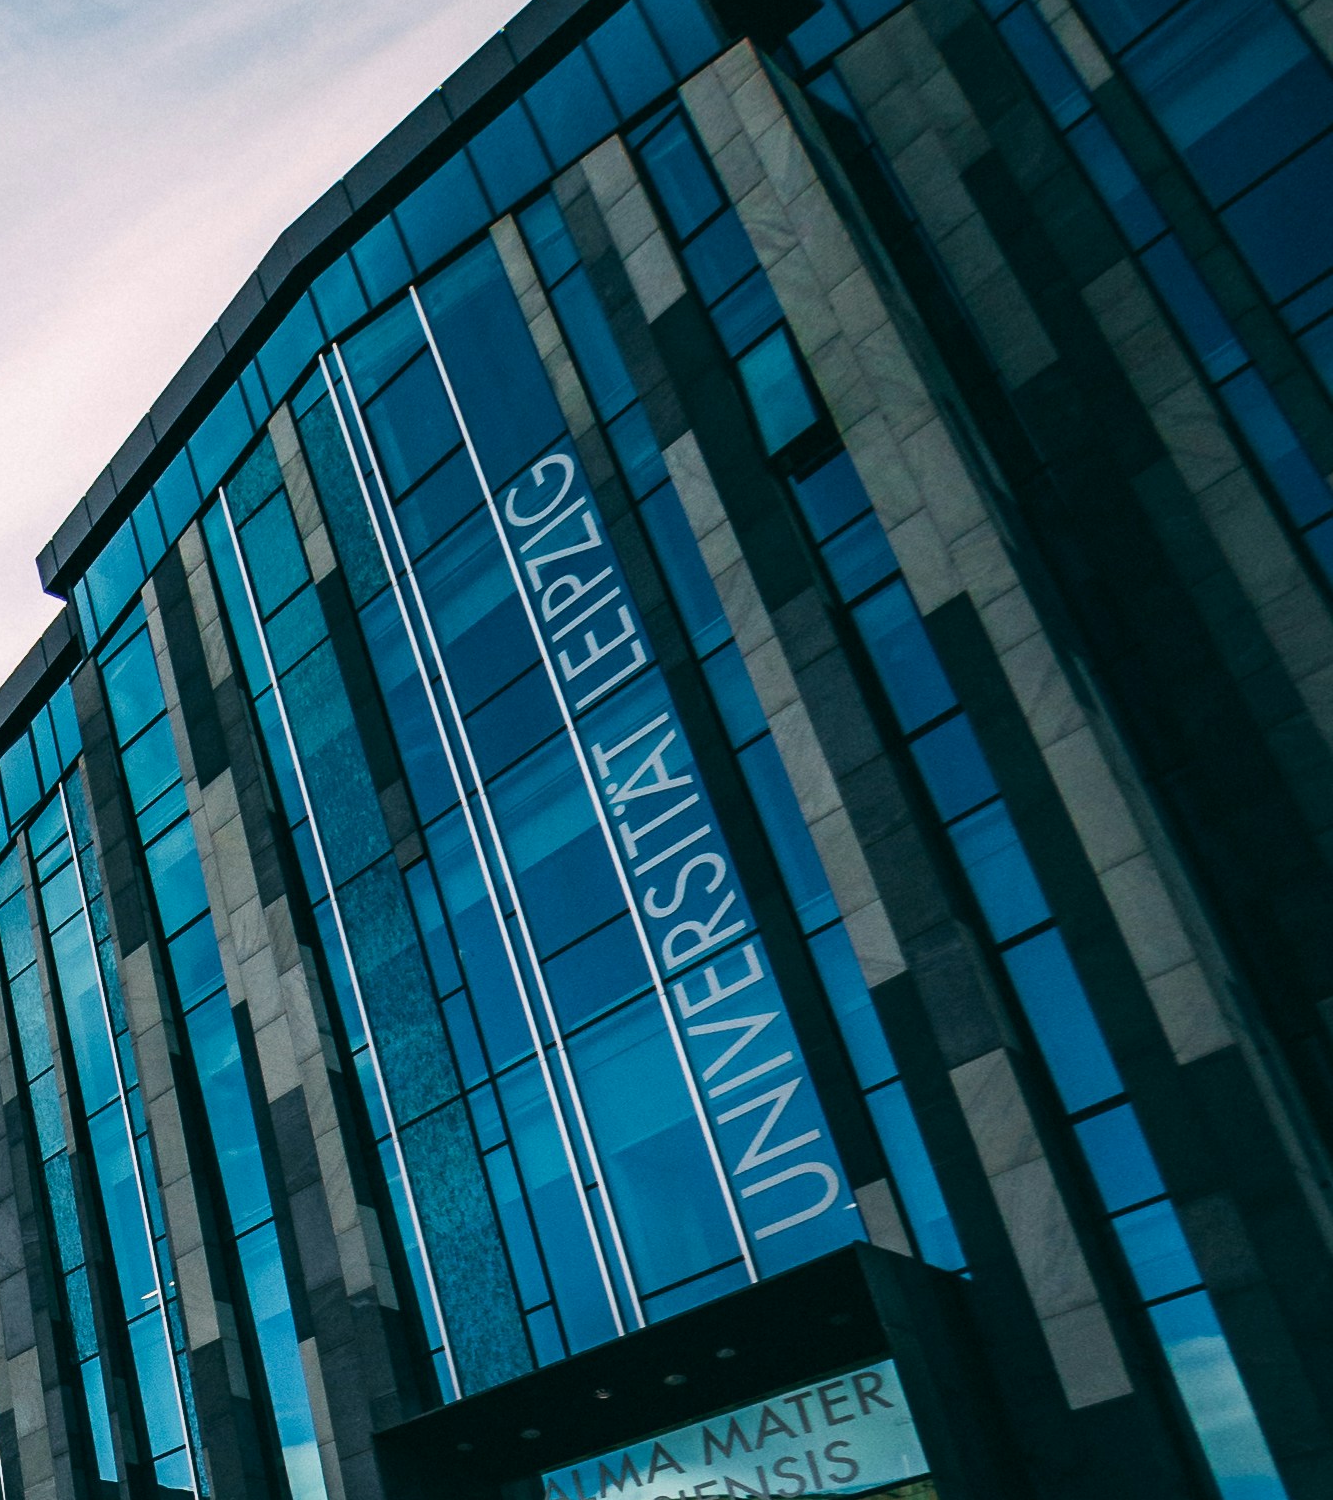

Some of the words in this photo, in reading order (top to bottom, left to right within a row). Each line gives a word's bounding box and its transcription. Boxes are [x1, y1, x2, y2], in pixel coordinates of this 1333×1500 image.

[505, 453, 647, 710] LEIPZIG
[592, 712, 840, 1241] UNIVERSITÄT
[701, 1371, 893, 1466] MATER
